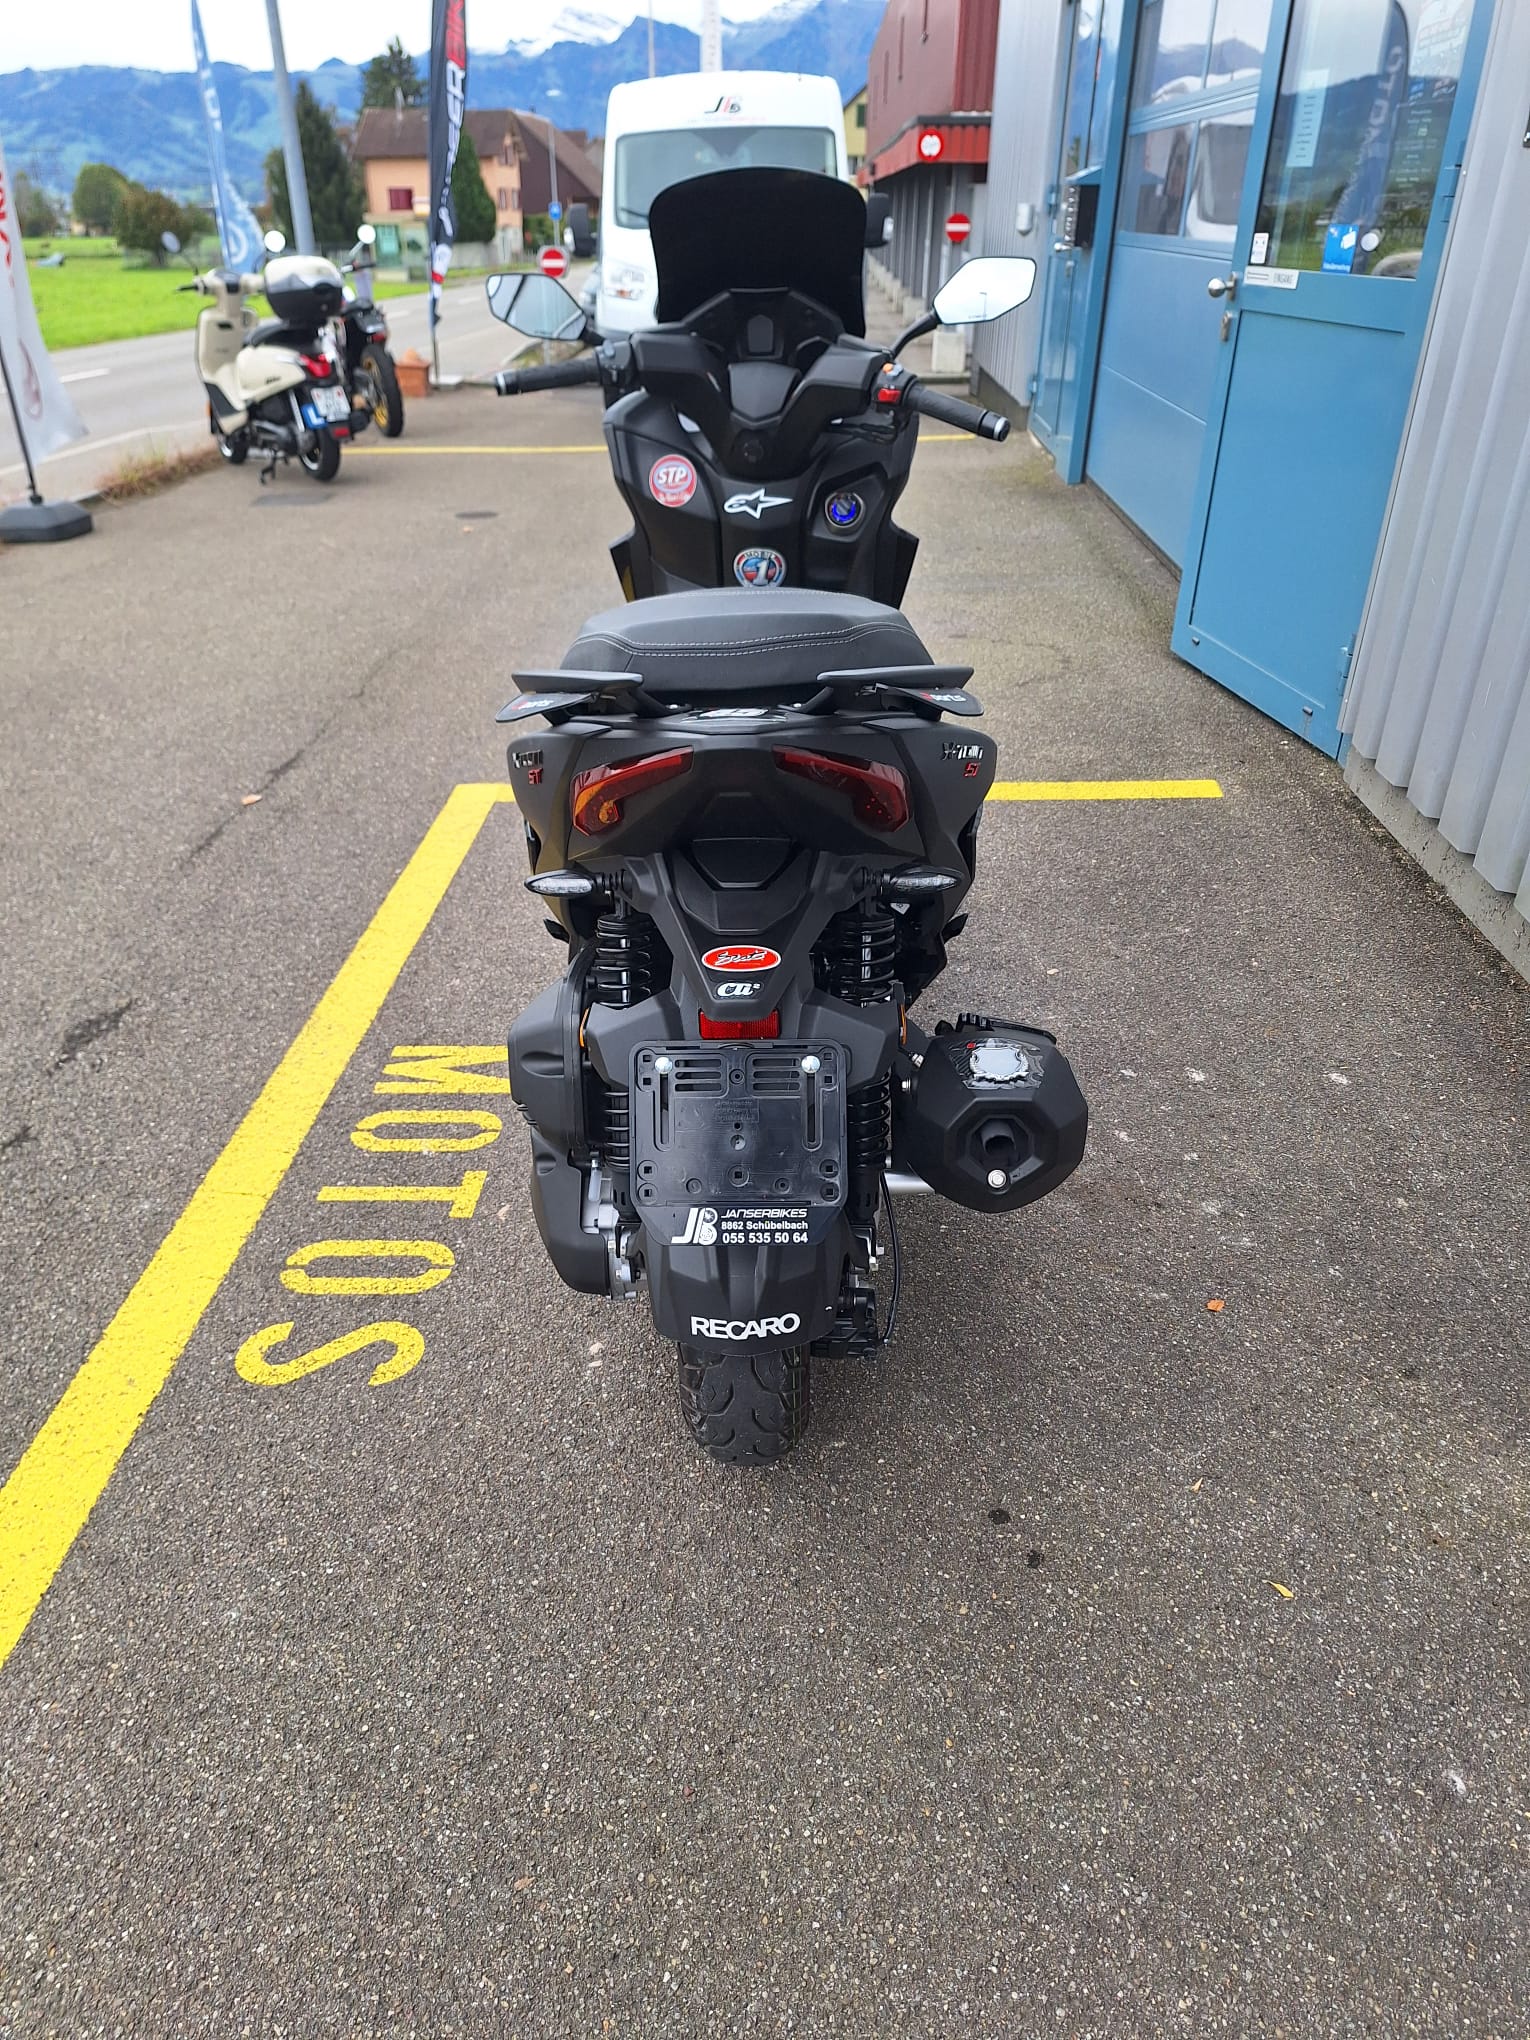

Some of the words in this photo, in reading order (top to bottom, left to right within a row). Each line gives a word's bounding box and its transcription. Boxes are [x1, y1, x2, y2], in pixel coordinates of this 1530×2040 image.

[657, 466, 687, 487] STP
[234, 1045, 512, 1386] MOTOS
[720, 1208, 808, 1219] JANSERBIKES
[721, 1221, 743, 1230] 8862
[746, 1220, 808, 1230] Schübelbach
[722, 1232, 745, 1244] 055
[748, 1232, 771, 1244] 535
[774, 1232, 789, 1244] 50
[793, 1232, 808, 1244] 64
[690, 1312, 801, 1341] RECARO
